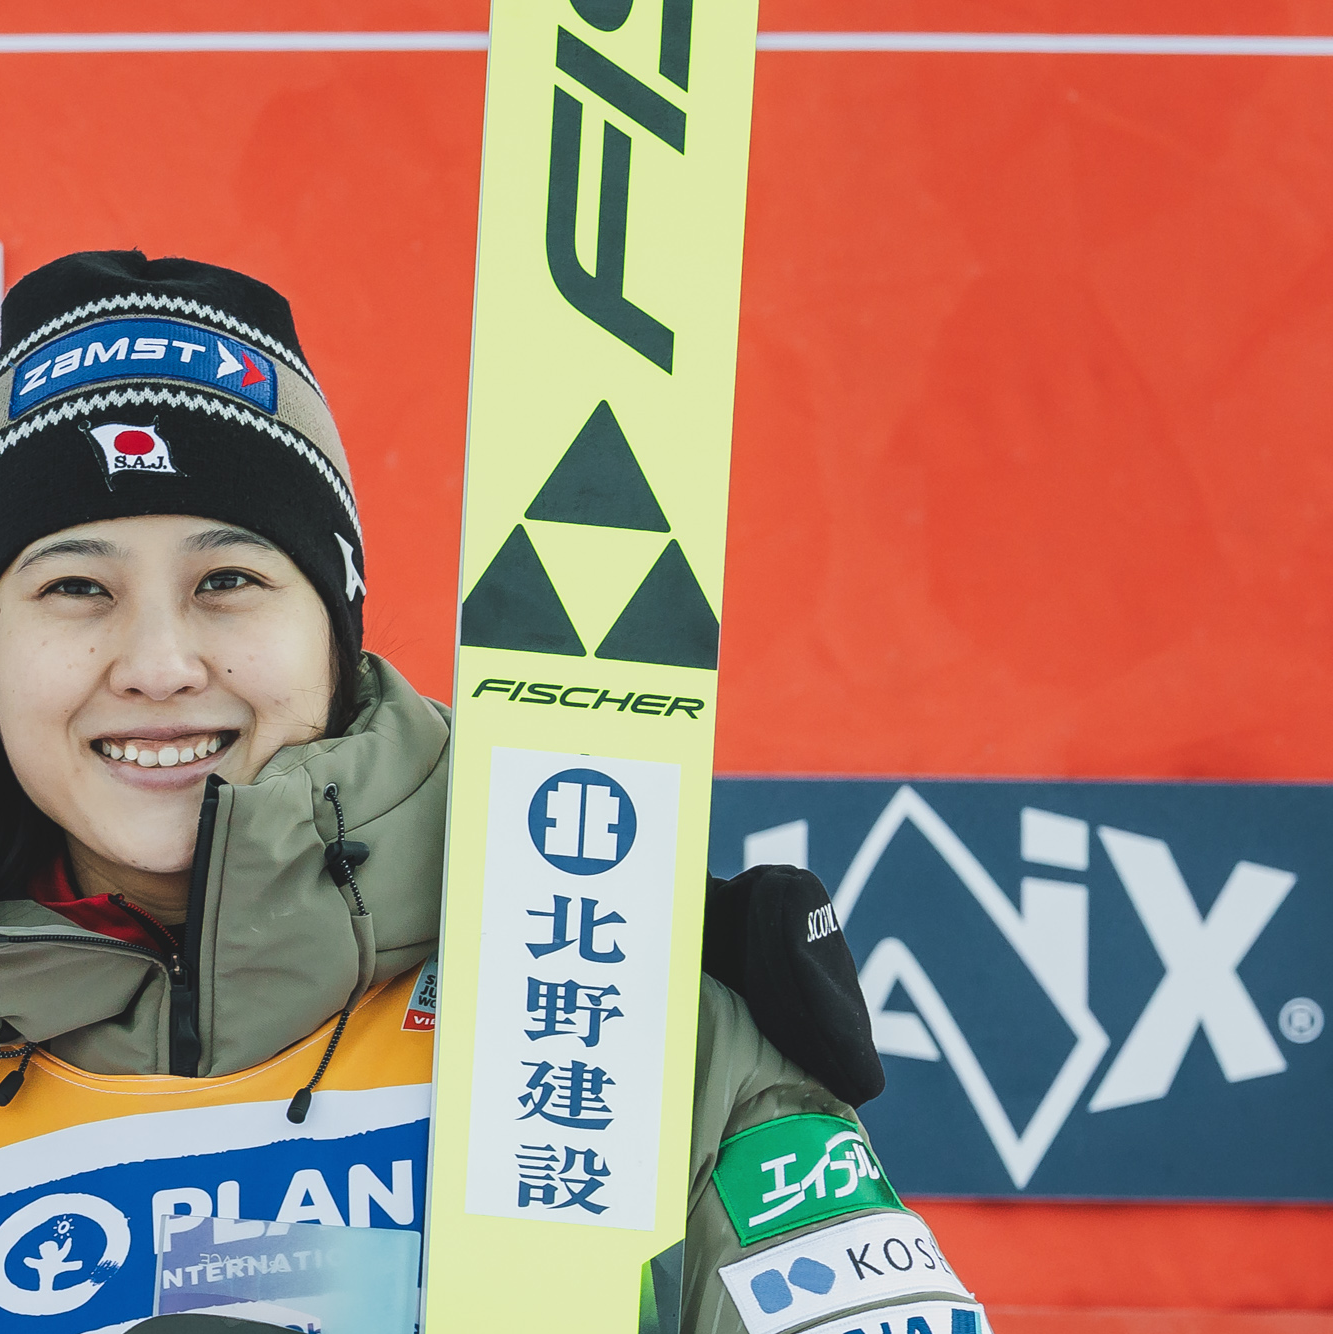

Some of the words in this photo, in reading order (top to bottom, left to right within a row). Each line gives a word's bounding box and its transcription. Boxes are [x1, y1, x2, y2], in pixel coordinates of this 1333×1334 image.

[113, 454, 169, 471] S.A.J.
[471, 677, 705, 720] FISCHER
[515, 894, 628, 1216] 北野建設
[151, 1159, 414, 1256] PLAN
[749, 1130, 881, 1228] エイブル
